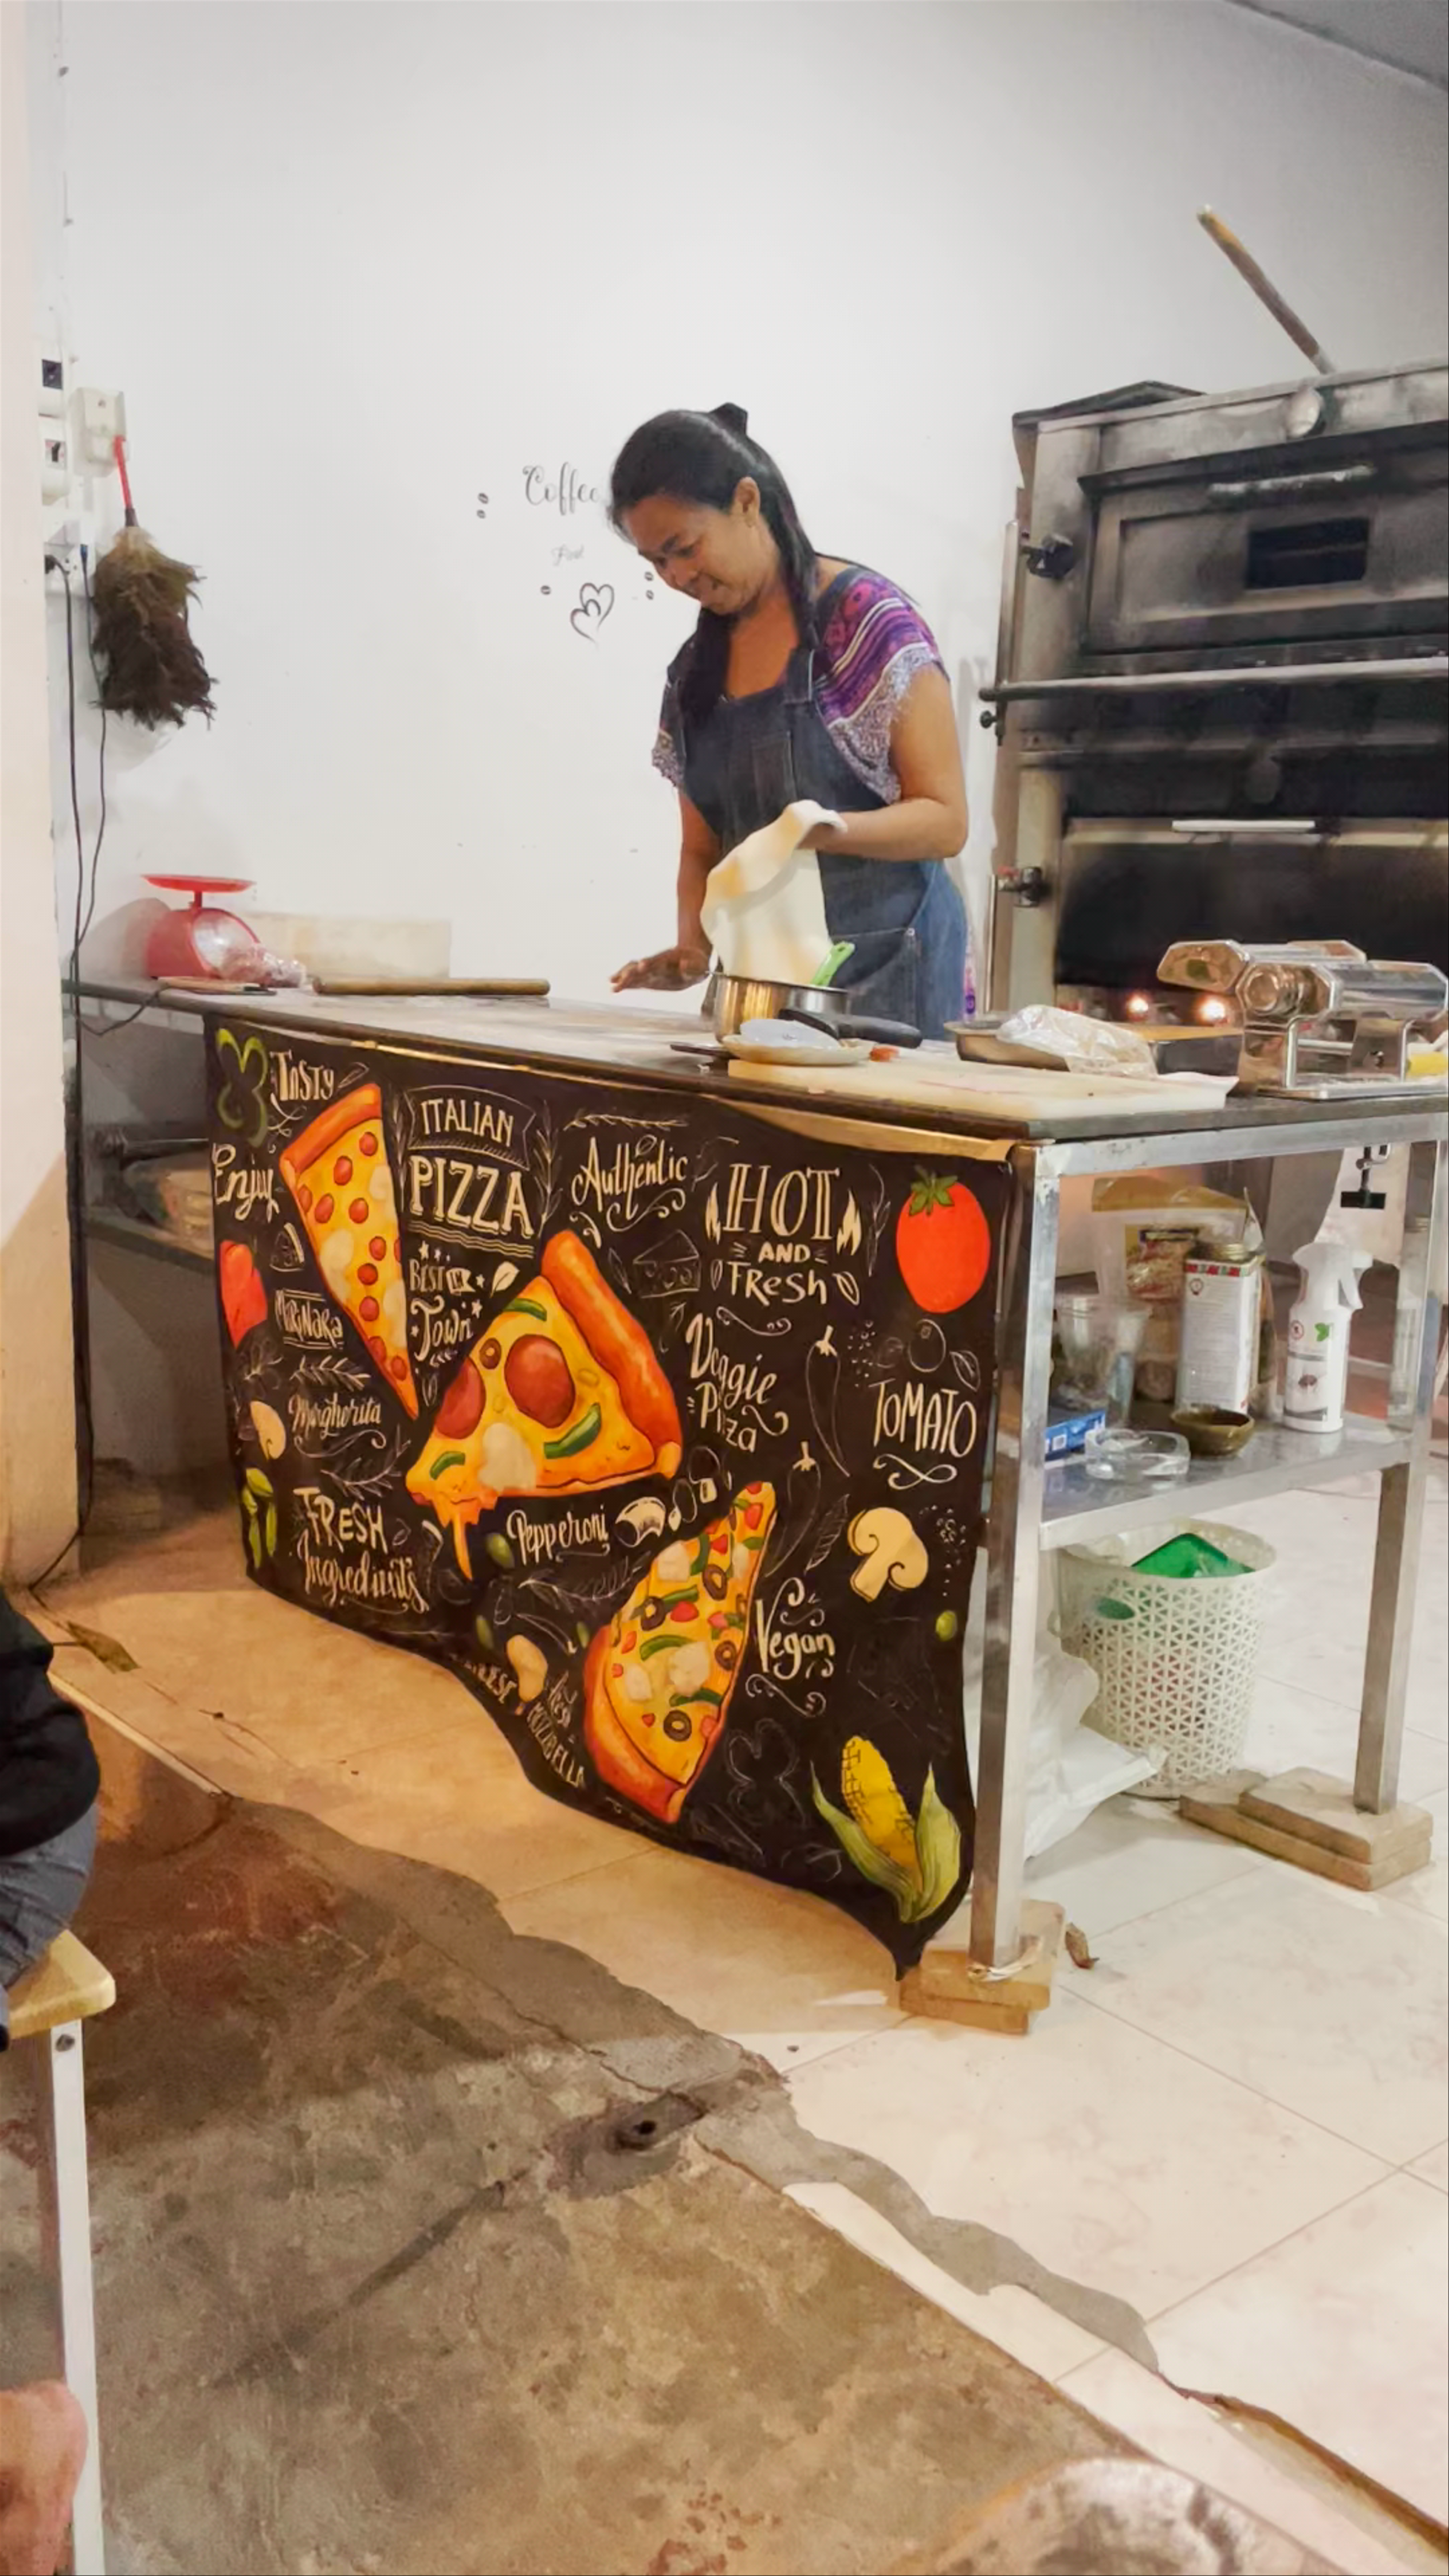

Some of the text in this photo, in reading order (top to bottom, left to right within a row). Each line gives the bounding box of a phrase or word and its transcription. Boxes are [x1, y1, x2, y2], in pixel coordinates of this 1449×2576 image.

[523, 461, 600, 515] Coffee
[420, 1098, 514, 1147] ITALIAN
[409, 1155, 534, 1240] PIZZA
[571, 1136, 688, 1220] Authentic
[723, 1163, 840, 1240] HOT
[408, 1258, 446, 1292] BEST
[758, 1241, 811, 1263] AND
[685, 1312, 777, 1410] Veggie
[868, 1378, 977, 1458] TOMATO
[292, 1486, 389, 1555] FRESH
[506, 1504, 609, 1566] Pepperoni
[755, 1577, 835, 1679] Vegan
